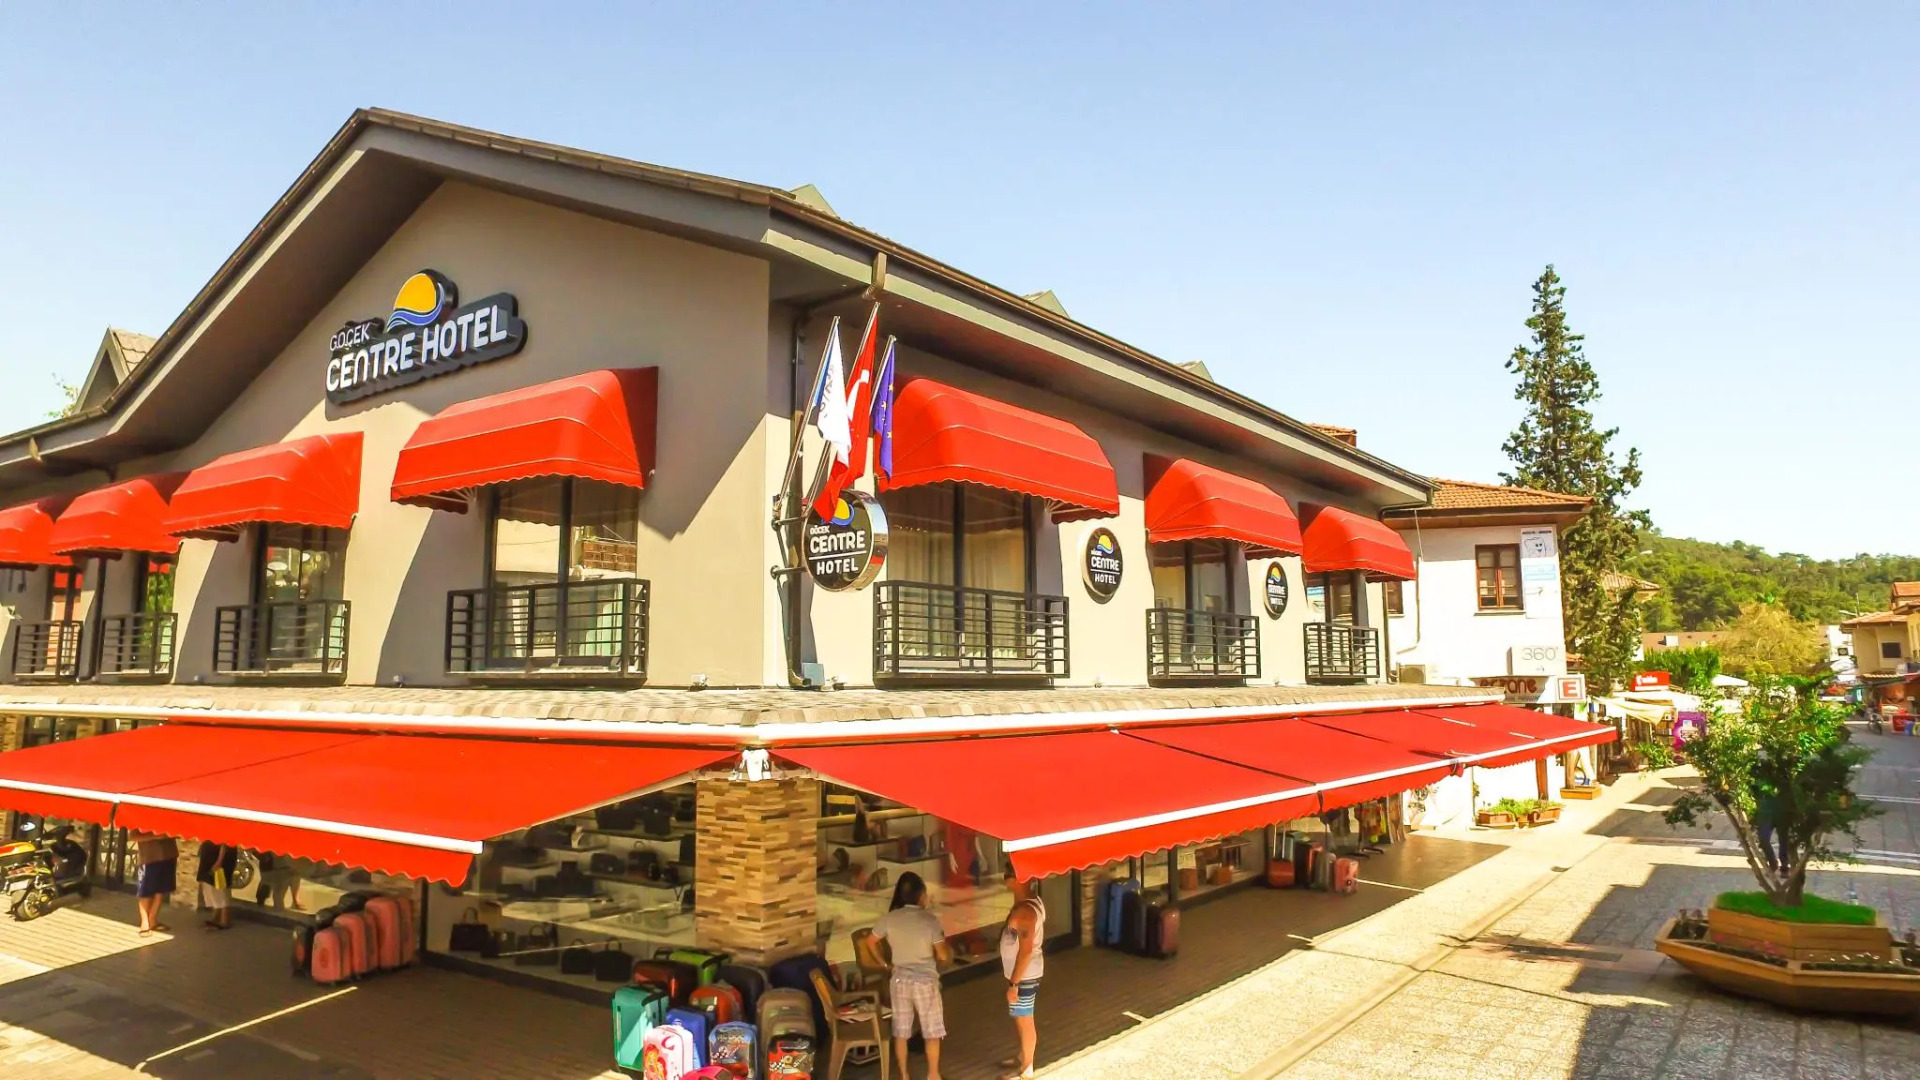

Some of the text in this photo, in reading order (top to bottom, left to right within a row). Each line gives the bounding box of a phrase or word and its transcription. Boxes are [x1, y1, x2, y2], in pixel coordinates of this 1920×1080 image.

[326, 304, 507, 392] CENTRE HOTEL
[810, 530, 866, 554] CENTRE
[816, 557, 859, 575] HOTEL
[1091, 556, 1120, 571] CENTRE
[1094, 573, 1117, 584] HOTEL
[1562, 681, 1578, 697] E
